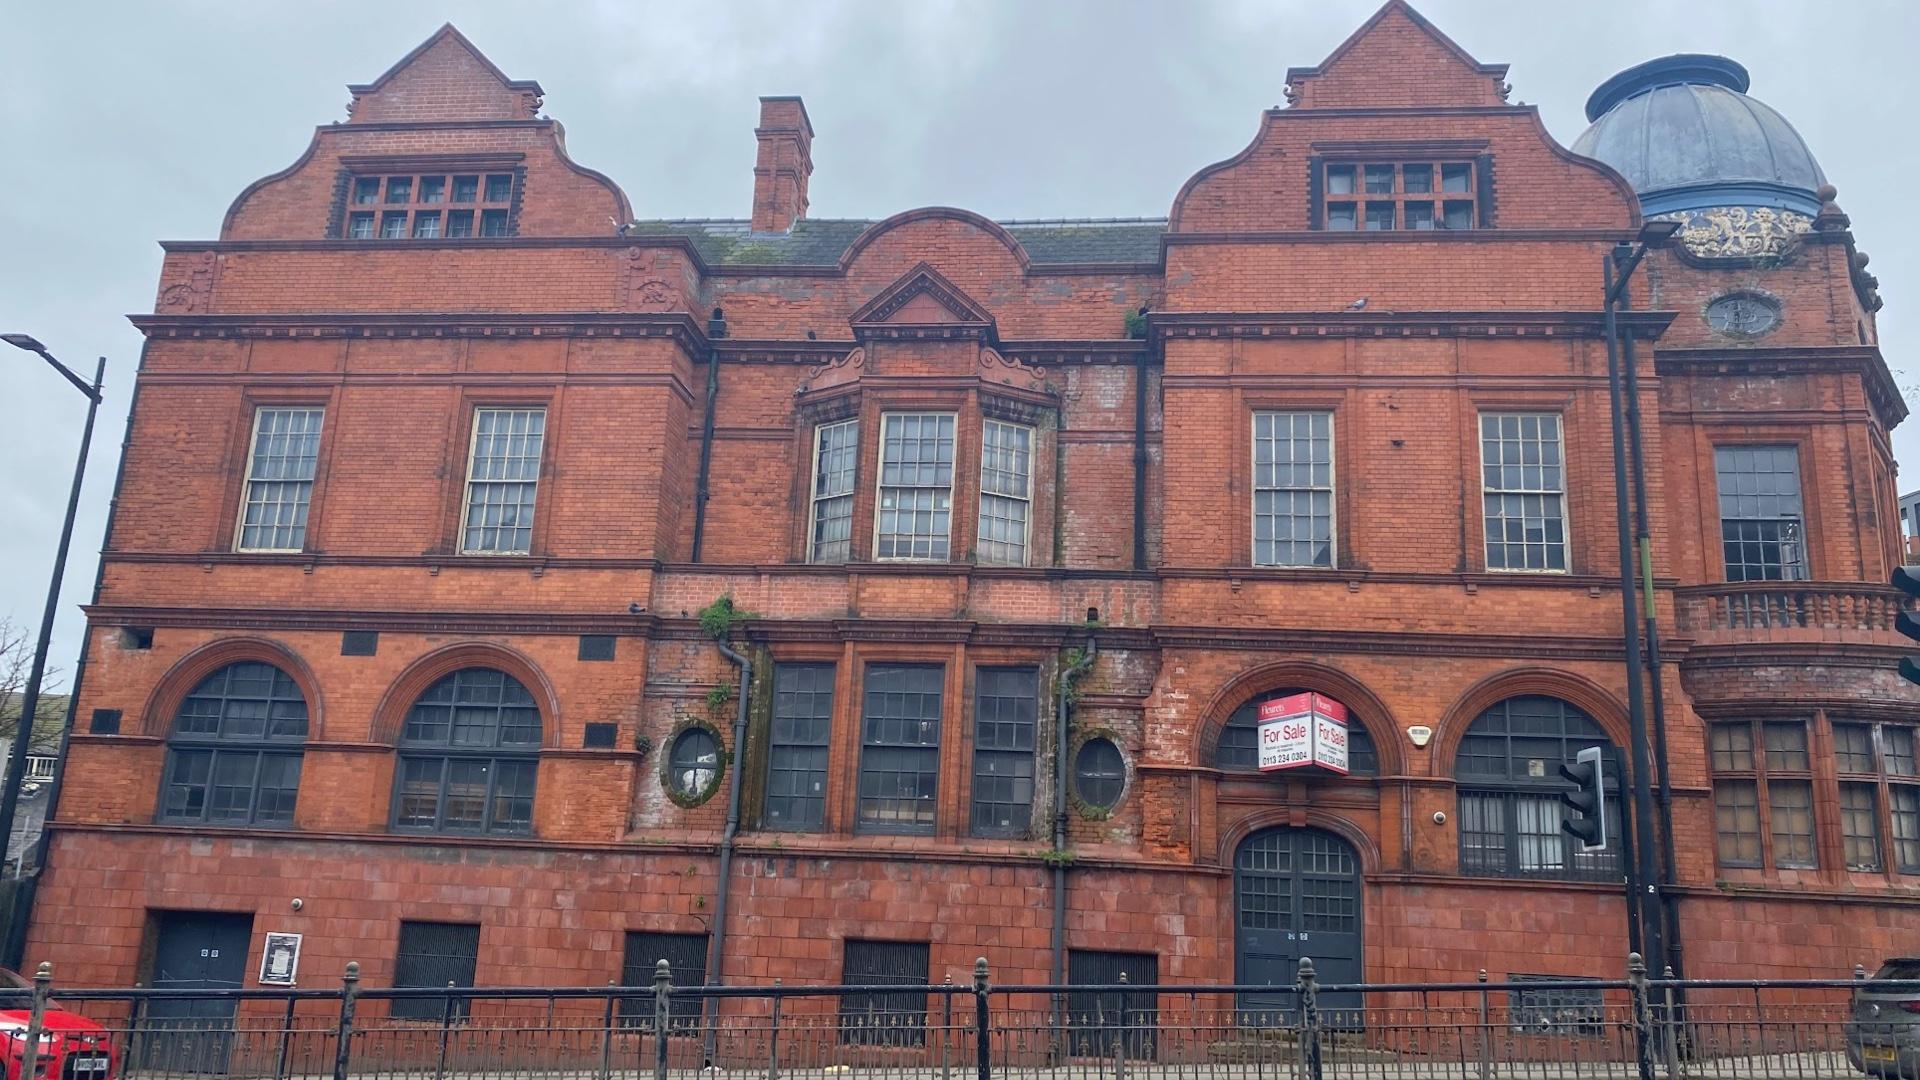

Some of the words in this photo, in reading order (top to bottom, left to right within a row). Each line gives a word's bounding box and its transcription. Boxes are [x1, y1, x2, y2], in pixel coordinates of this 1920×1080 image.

[1264, 729, 1280, 744] For
[1283, 723, 1306, 740] Sale
[1319, 723, 1330, 740] For
[1331, 728, 1345, 746] Sale
[1263, 755, 1277, 766] 0113
[1278, 753, 1290, 763] 234
[1648, 885, 1655, 893] 2
